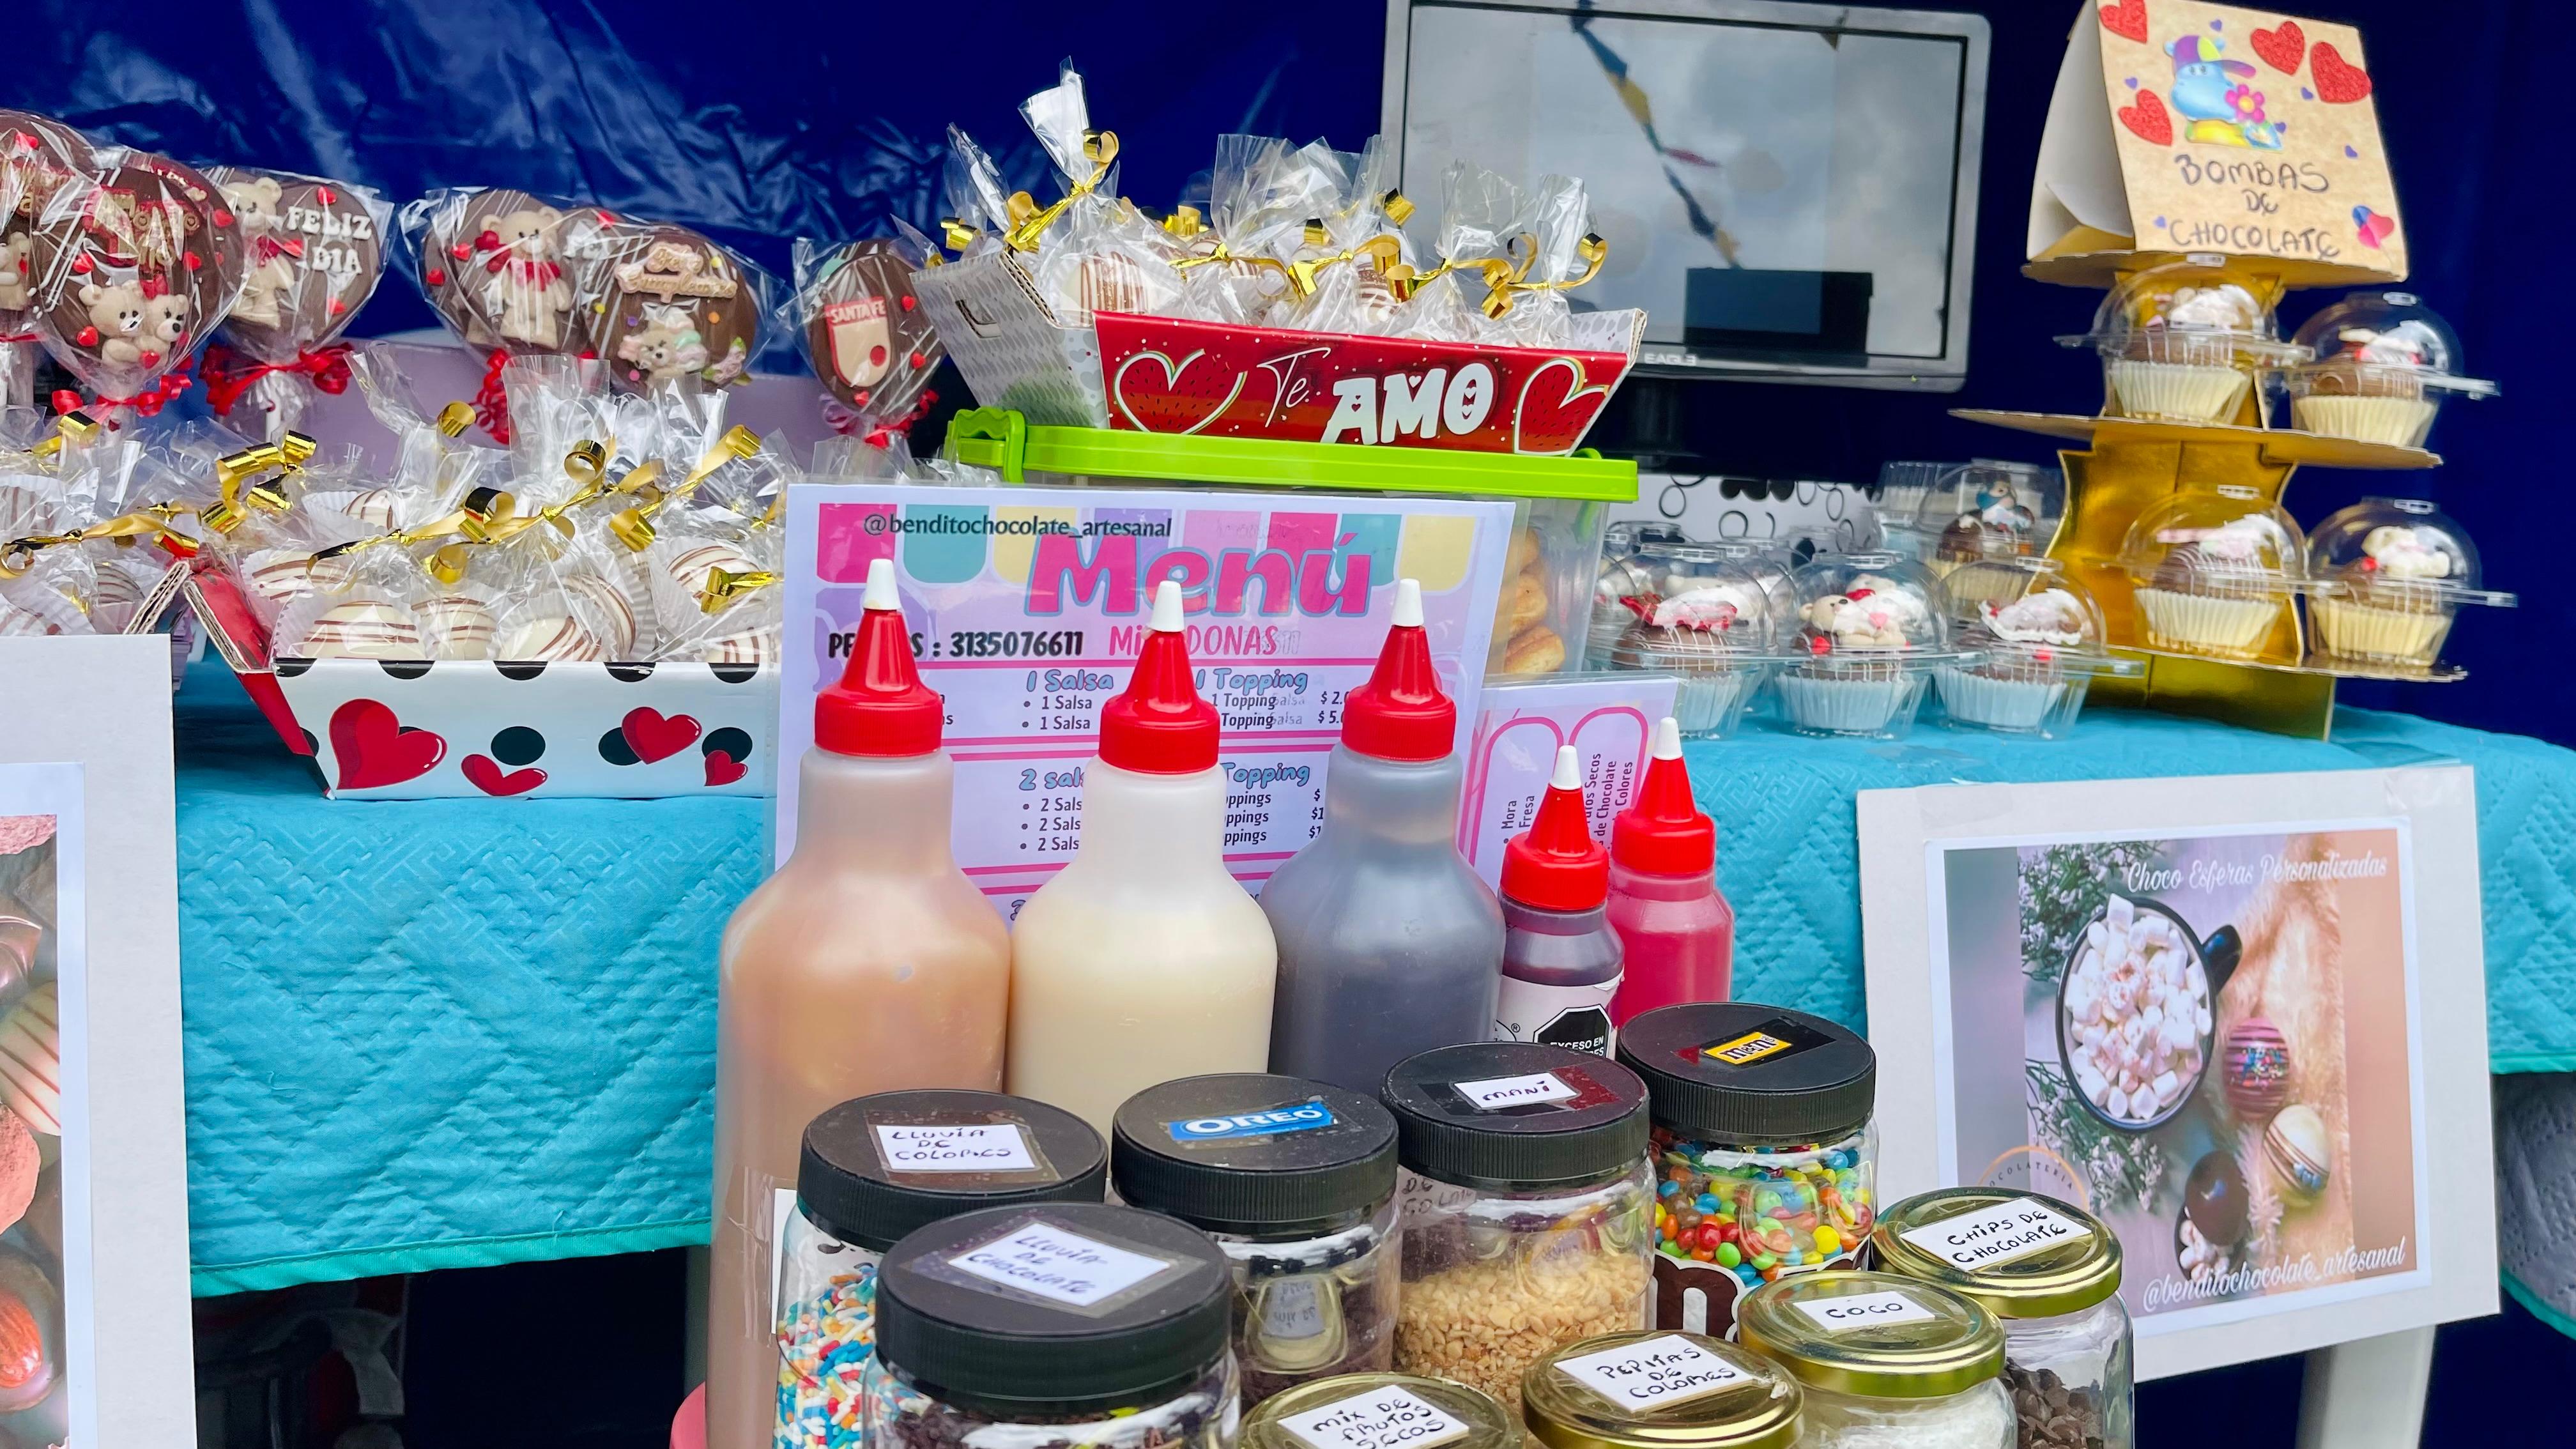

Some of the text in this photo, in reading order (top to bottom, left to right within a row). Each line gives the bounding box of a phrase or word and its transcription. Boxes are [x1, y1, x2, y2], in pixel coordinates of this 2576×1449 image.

[2174, 154, 2329, 192] BOMBAS
[2241, 189, 2279, 216] DE
[287, 206, 372, 240] FELIZ
[2170, 219, 2340, 260] CHOCOLATE
[831, 300, 886, 323] SANTA FE
[1257, 347, 1494, 445] Te AMO
[864, 513, 1172, 539] @benditochocolate_artesanal
[1024, 528, 1372, 618] Menú
[949, 631, 1084, 657] 3135076611
[1188, 626, 1278, 656] DONAS
[1045, 669, 1114, 693] Salsa
[1213, 668, 1308, 696] Topping
[1041, 694, 1092, 710] 1 Salsa
[1223, 693, 1276, 710] Topping
[1040, 715, 1091, 730] 1 Salsa
[1222, 712, 1275, 730] Topping
[1019, 767, 1084, 790] 2 sal
[1584, 753, 1601, 789] Secos
[1596, 760, 1617, 817] Chocolate
[1614, 761, 1633, 807] Colores
[1041, 797, 1082, 811] 2 Sals
[1226, 791, 1271, 808] ppings
[1039, 816, 1081, 831] 2 Sals
[1225, 809, 1269, 827] ppings
[1311, 807, 1324, 820] $1
[1501, 800, 1517, 829] Mora
[1519, 795, 1535, 829] Fresa
[1038, 836, 1080, 851] 2 Sals
[1224, 829, 1267, 846] ppings
[2128, 850, 2388, 894] Choco Esferas Personalizadas
[1593, 1036, 1604, 1048] EN
[1185, 1109, 1323, 1133] OREO
[892, 1128, 988, 1139] LLUVIA
[896, 1148, 1011, 1160] COLORES
[1988, 1161, 2073, 1190] OCOLATERIA
[2019, 1210, 2048, 1225] DE
[1952, 1223, 2067, 1264] CHOCOLATE
[1826, 1303, 1903, 1319] COCO
[1597, 1347, 1701, 1378] PEPITAS
[1648, 1368, 1682, 1381] DE
[1377, 1399, 1411, 1413] DE
[1356, 1419, 1445, 1449] SECOS
